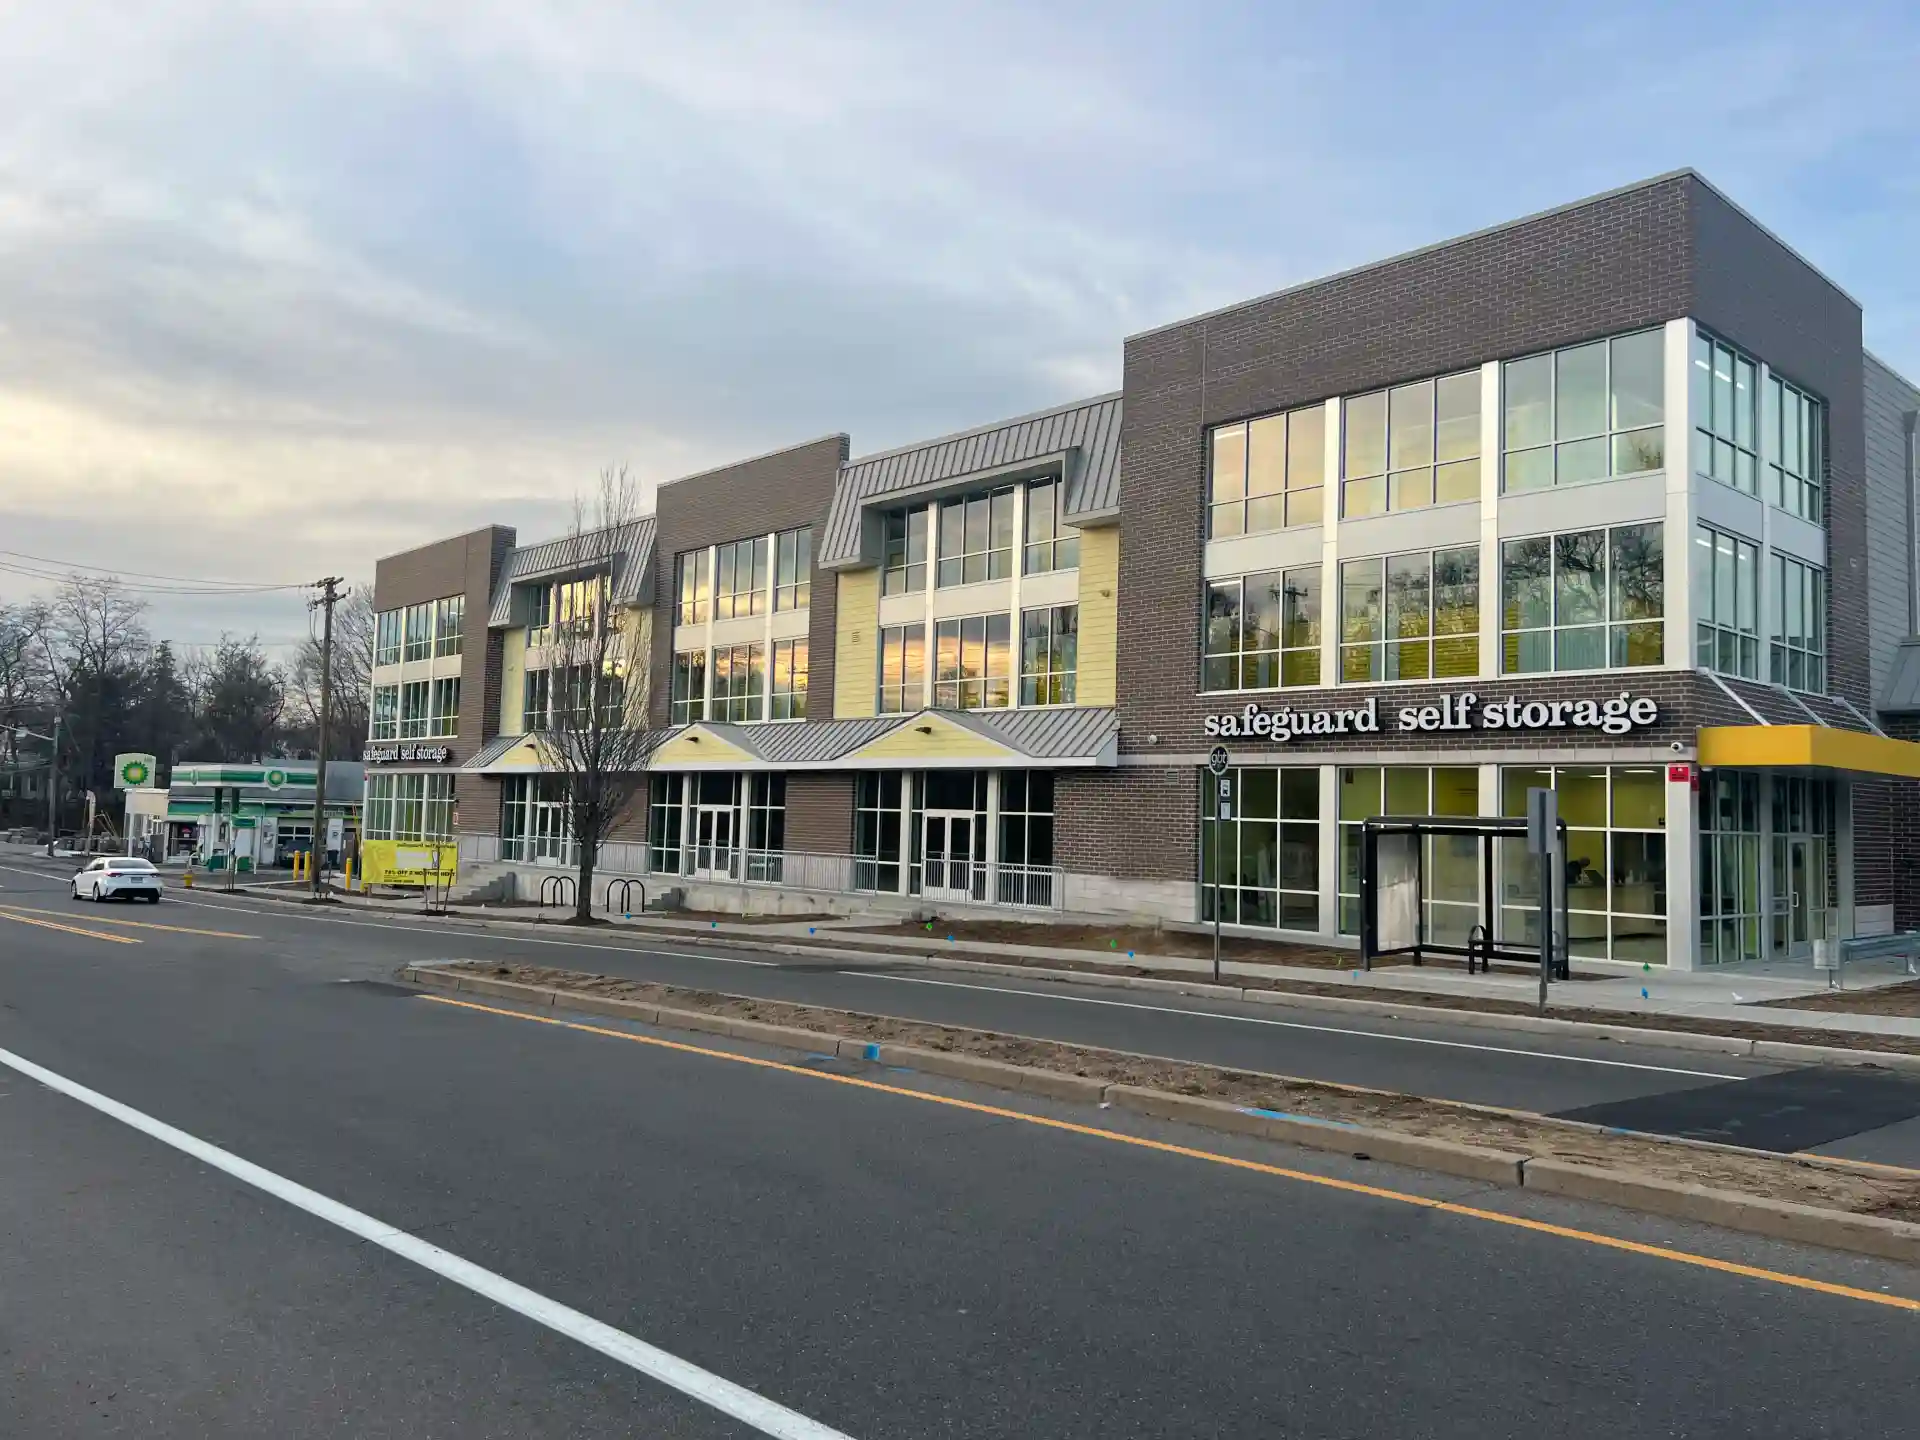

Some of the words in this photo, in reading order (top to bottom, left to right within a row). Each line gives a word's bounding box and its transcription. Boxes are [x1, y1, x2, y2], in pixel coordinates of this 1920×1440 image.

[1204, 698, 1378, 741] safeguard
[1399, 692, 1475, 730] self
[1482, 692, 1657, 734] storage
[363, 745, 398, 763] safeguard
[401, 744, 416, 760] self
[417, 745, 447, 763] storage
